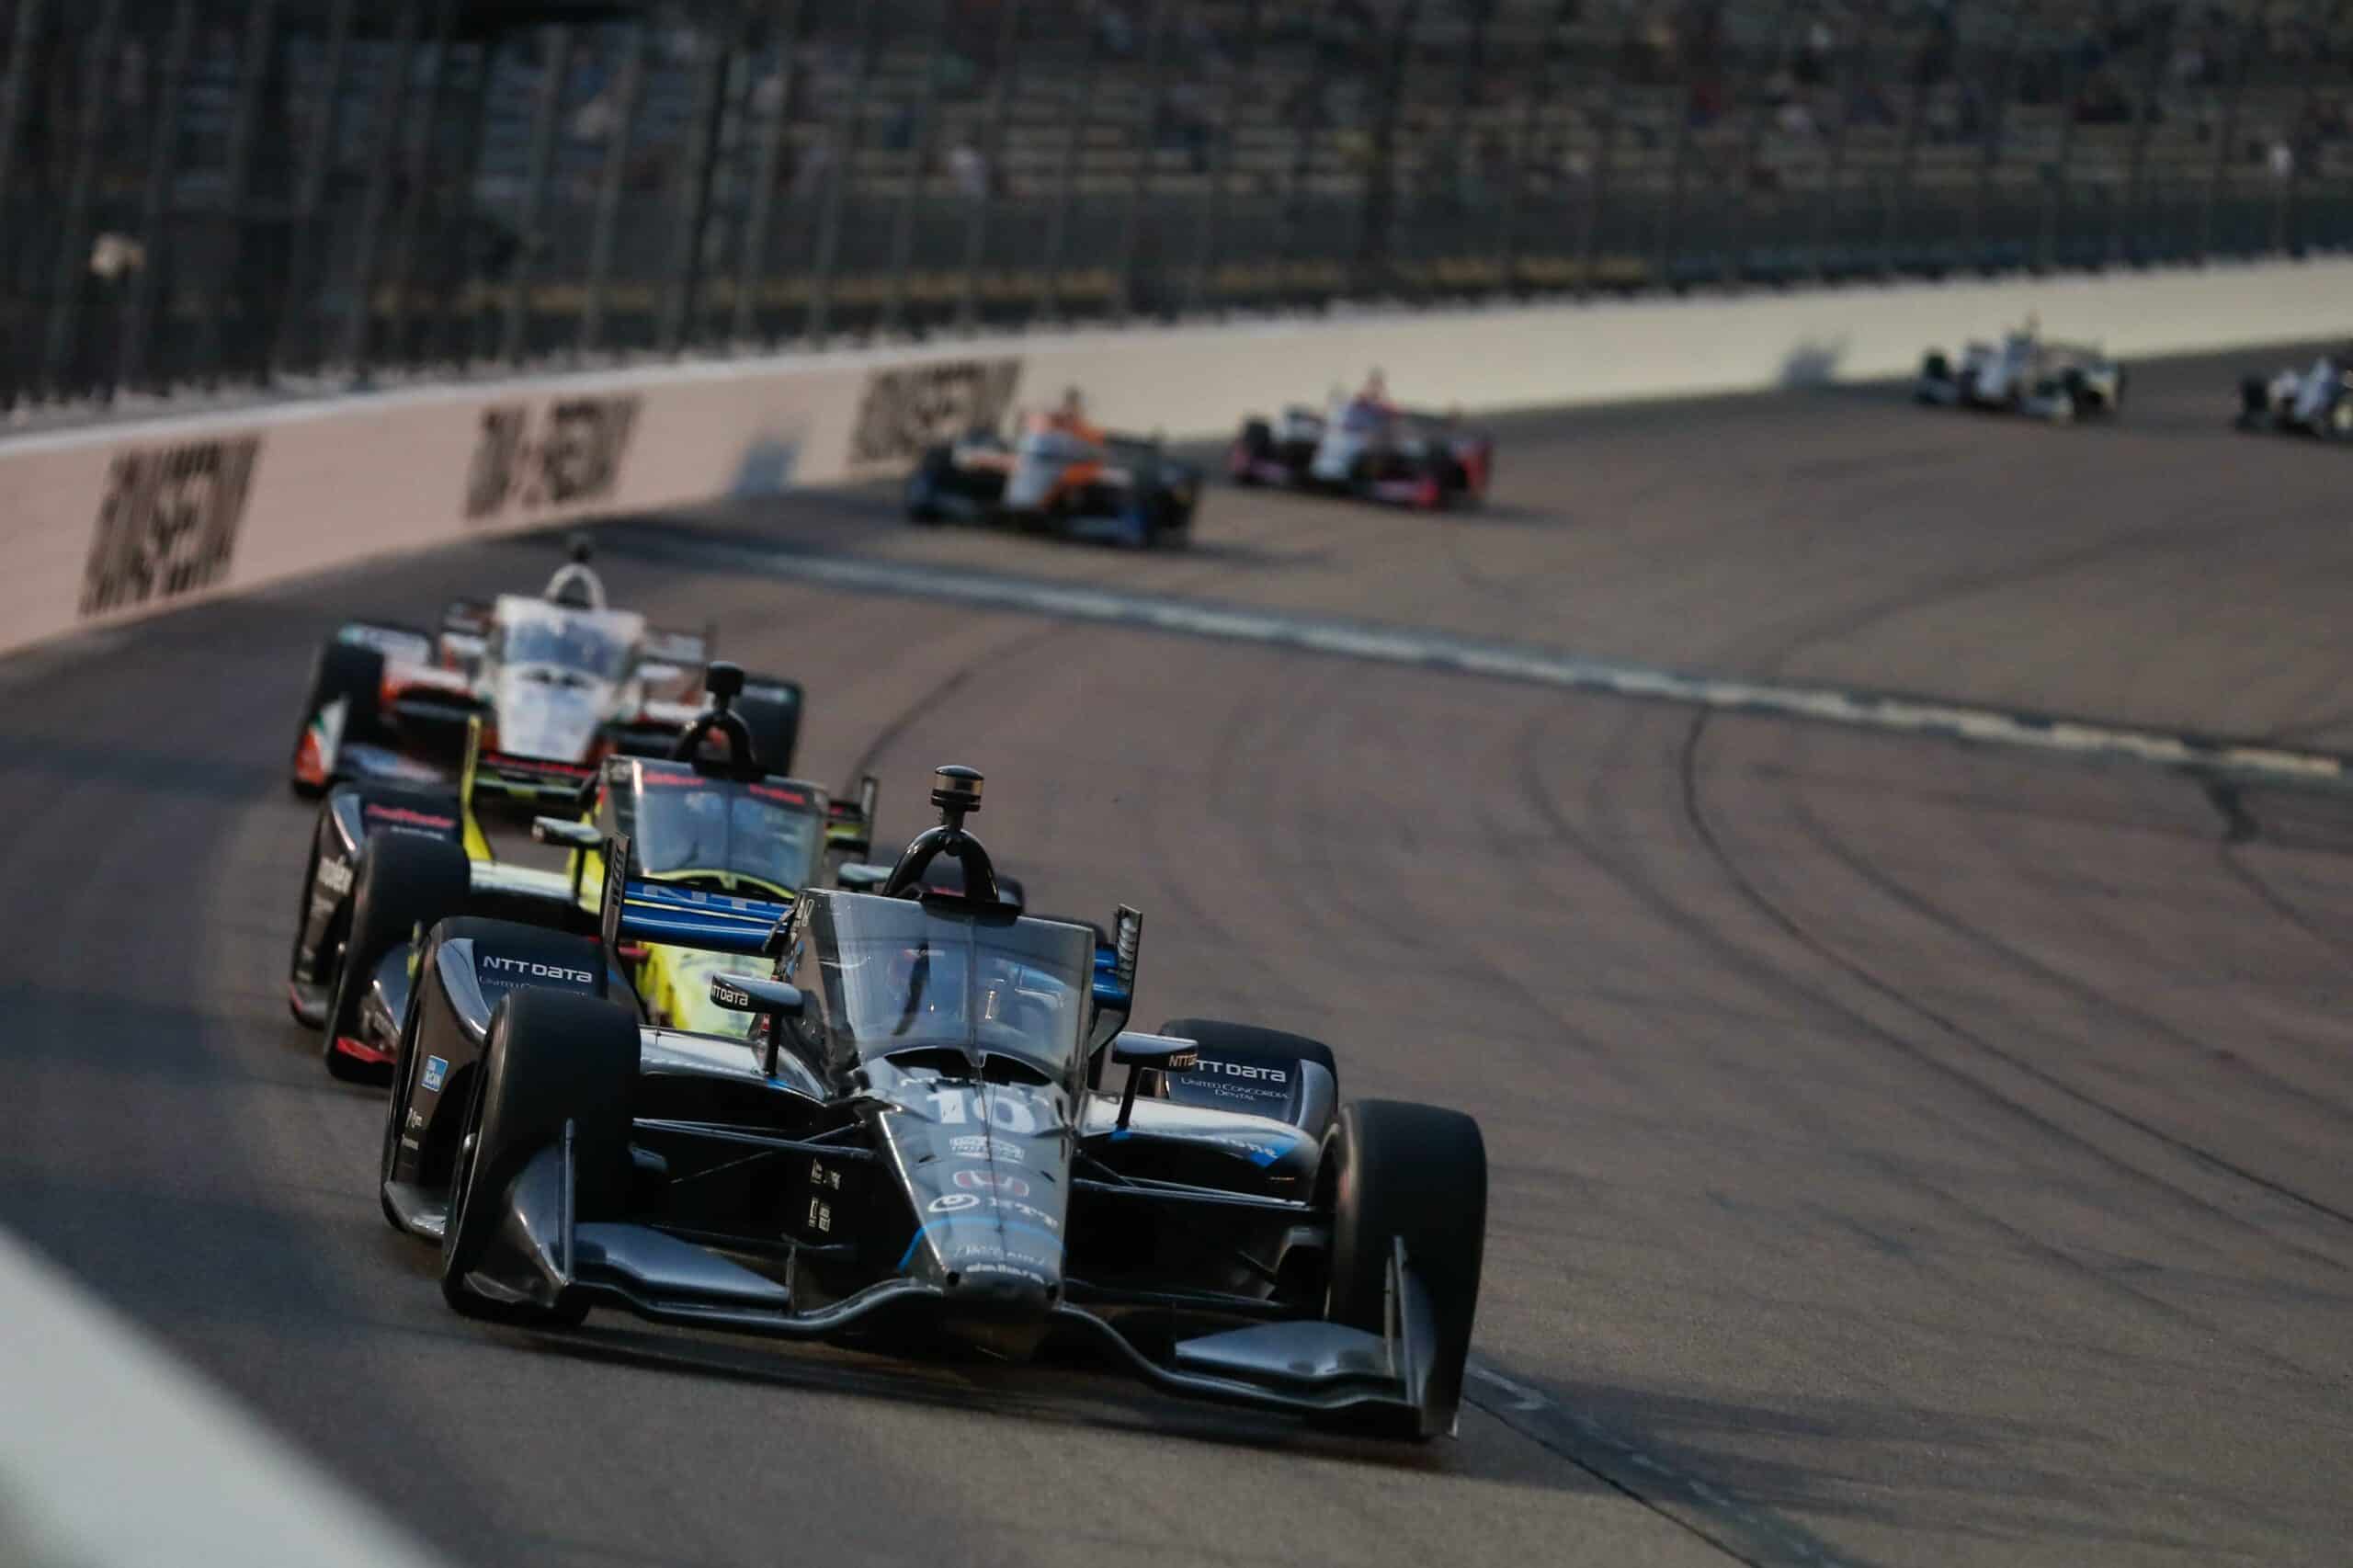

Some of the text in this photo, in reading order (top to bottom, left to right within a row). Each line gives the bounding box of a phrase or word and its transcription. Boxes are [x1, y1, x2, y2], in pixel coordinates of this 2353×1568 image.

[483, 956, 529, 973] NTT
[1196, 1059, 1223, 1074] TT
[926, 1088, 1036, 1133] 10
